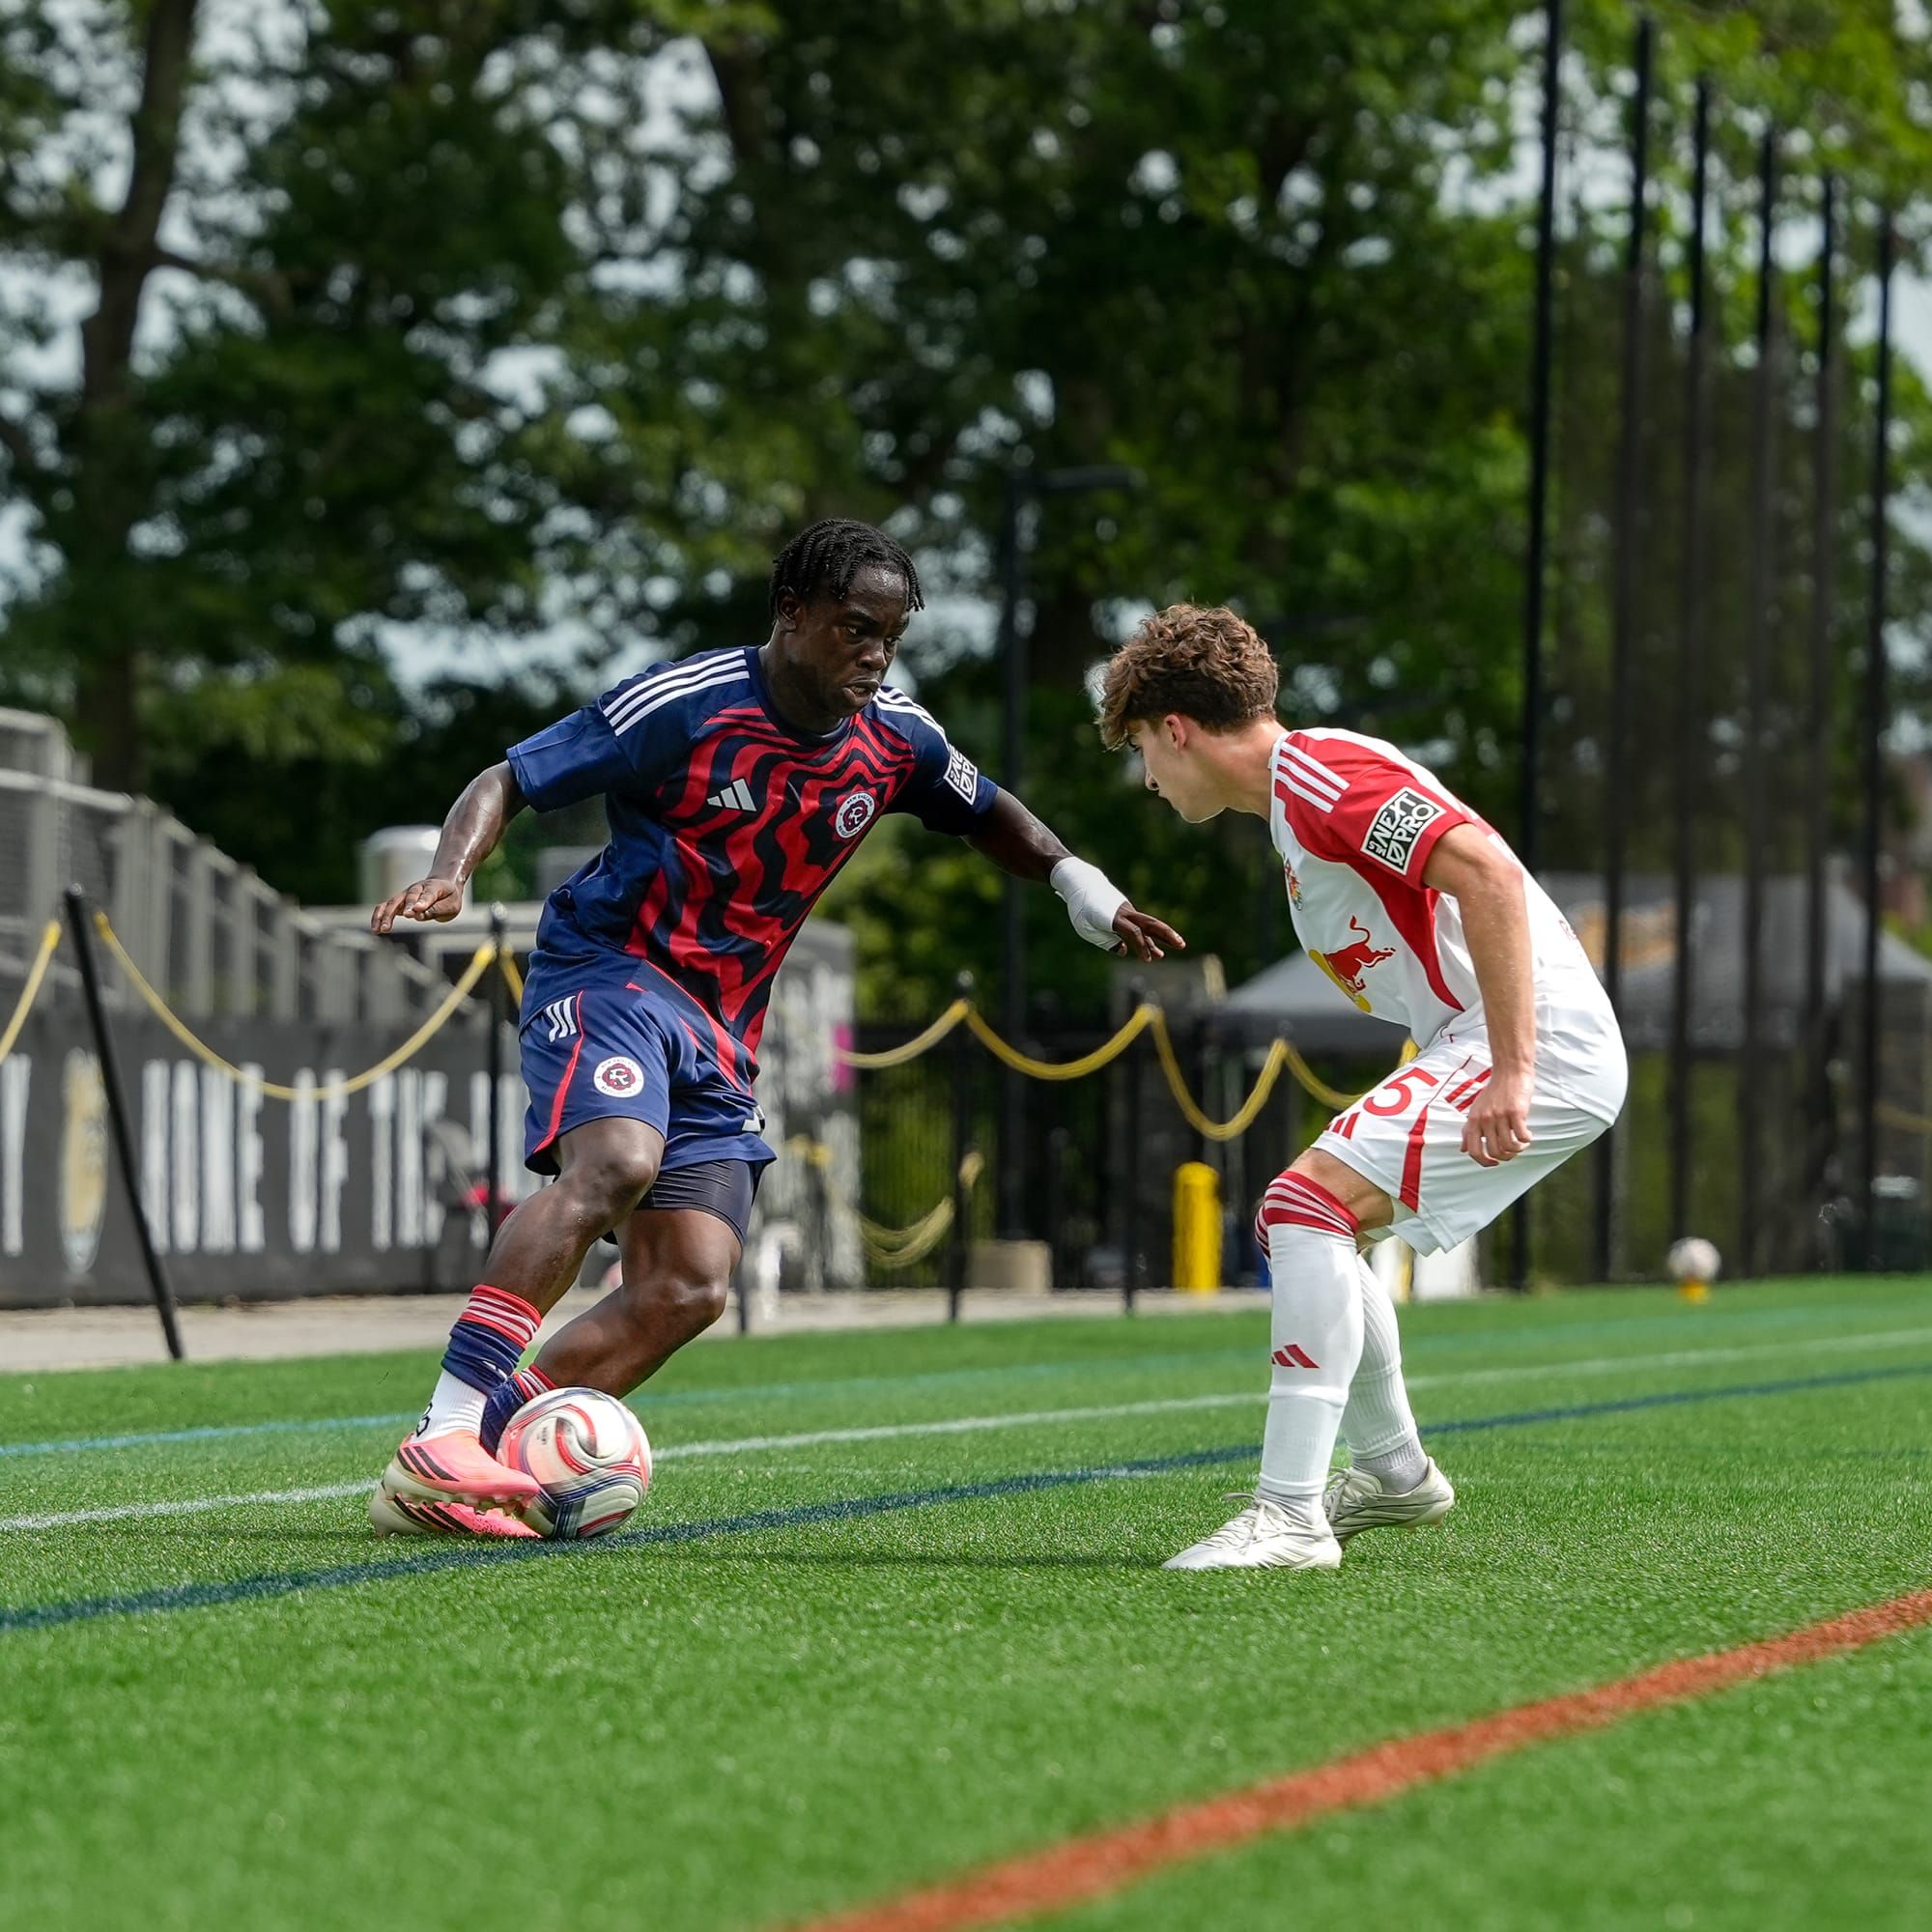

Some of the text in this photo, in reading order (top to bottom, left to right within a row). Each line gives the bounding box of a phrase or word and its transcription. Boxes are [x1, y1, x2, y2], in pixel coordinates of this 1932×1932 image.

[1372, 792, 1416, 848] NEXT
[1392, 804, 1435, 843] PRO
[140, 1059, 265, 1255] HOME
[289, 1066, 349, 1253] OF
